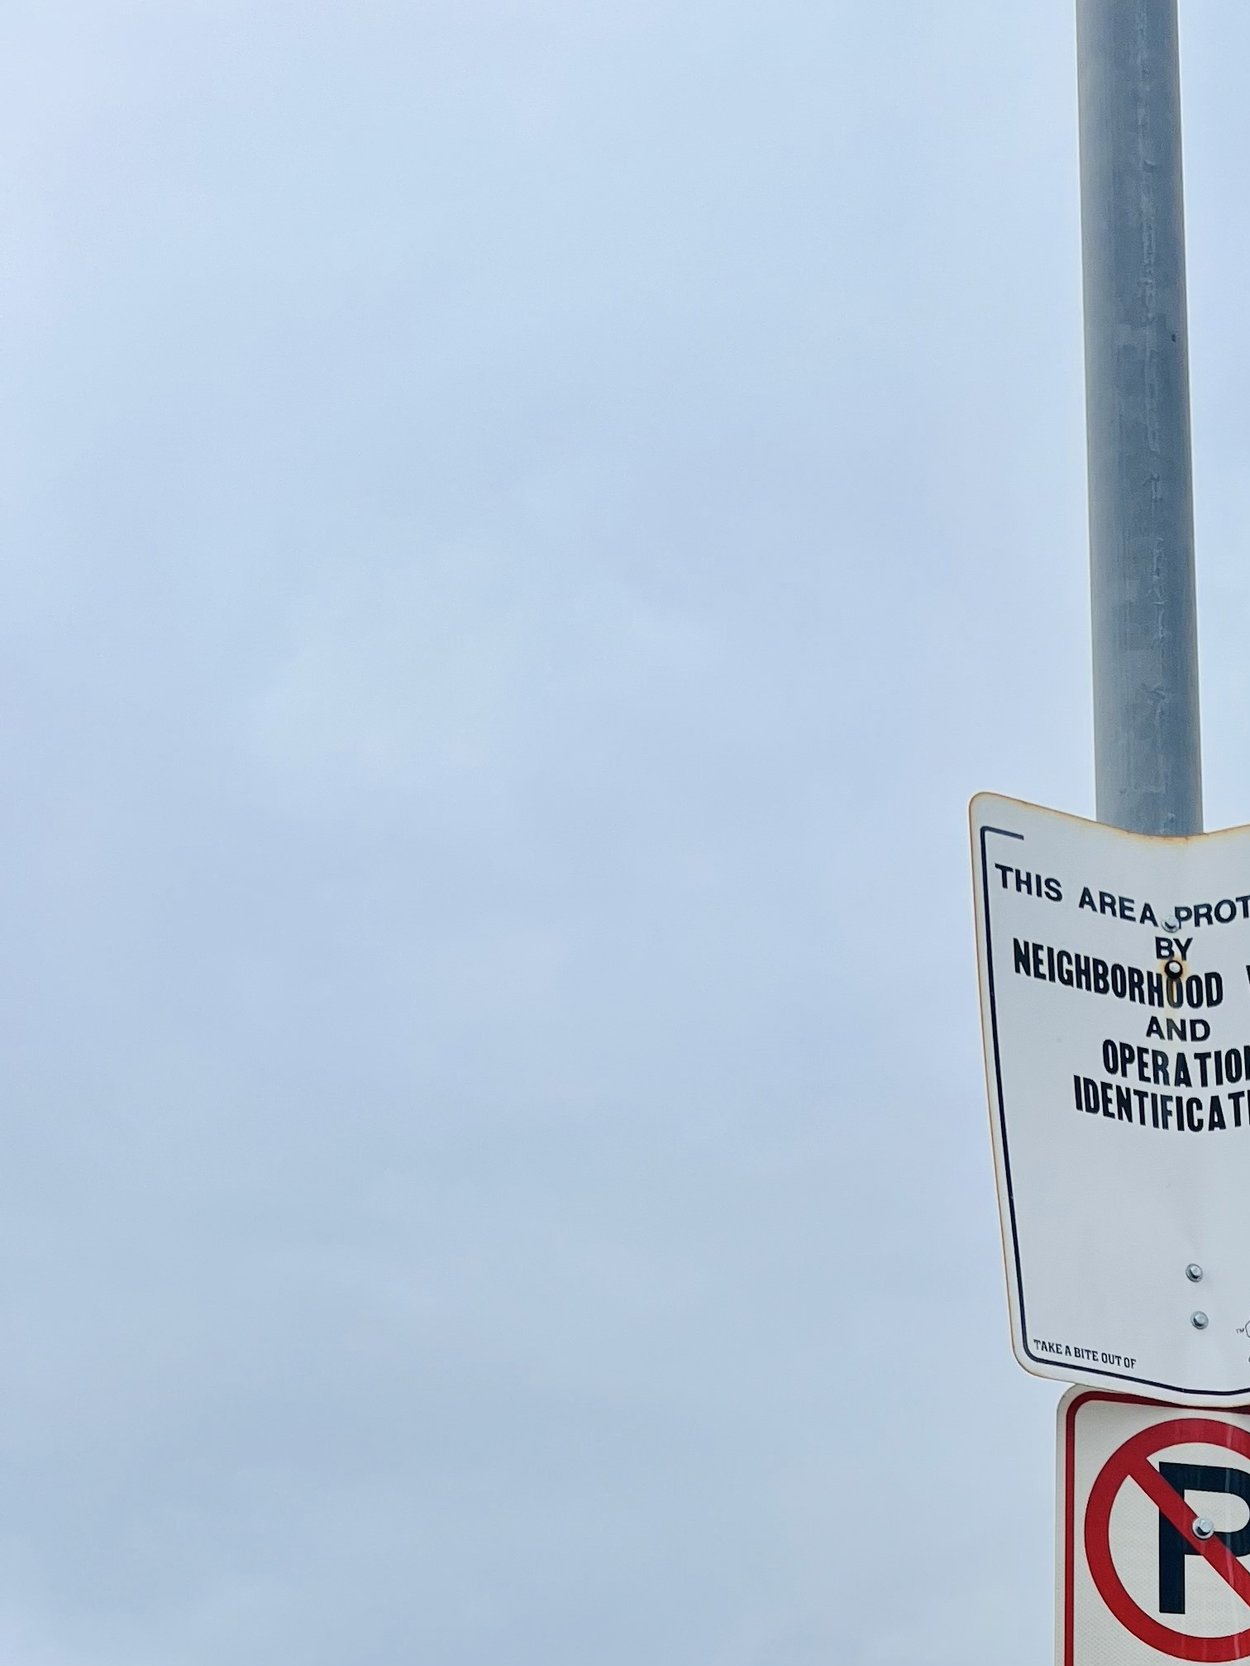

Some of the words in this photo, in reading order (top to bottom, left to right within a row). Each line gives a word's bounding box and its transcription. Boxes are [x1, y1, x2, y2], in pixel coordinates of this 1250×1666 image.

[995, 863, 1063, 901] THIS
[1078, 887, 1160, 928] AREA
[1154, 936, 1194, 961] BY
[1013, 938, 1224, 1009] NEIGHBORHOOD
[1145, 1016, 1211, 1042] AND
[1033, 1339, 1063, 1355] TAKE
[1064, 1345, 1073, 1357] A
[1073, 1346, 1099, 1362] BITE
[1101, 1352, 1122, 1367] OUT
[1123, 1357, 1137, 1369] OF
